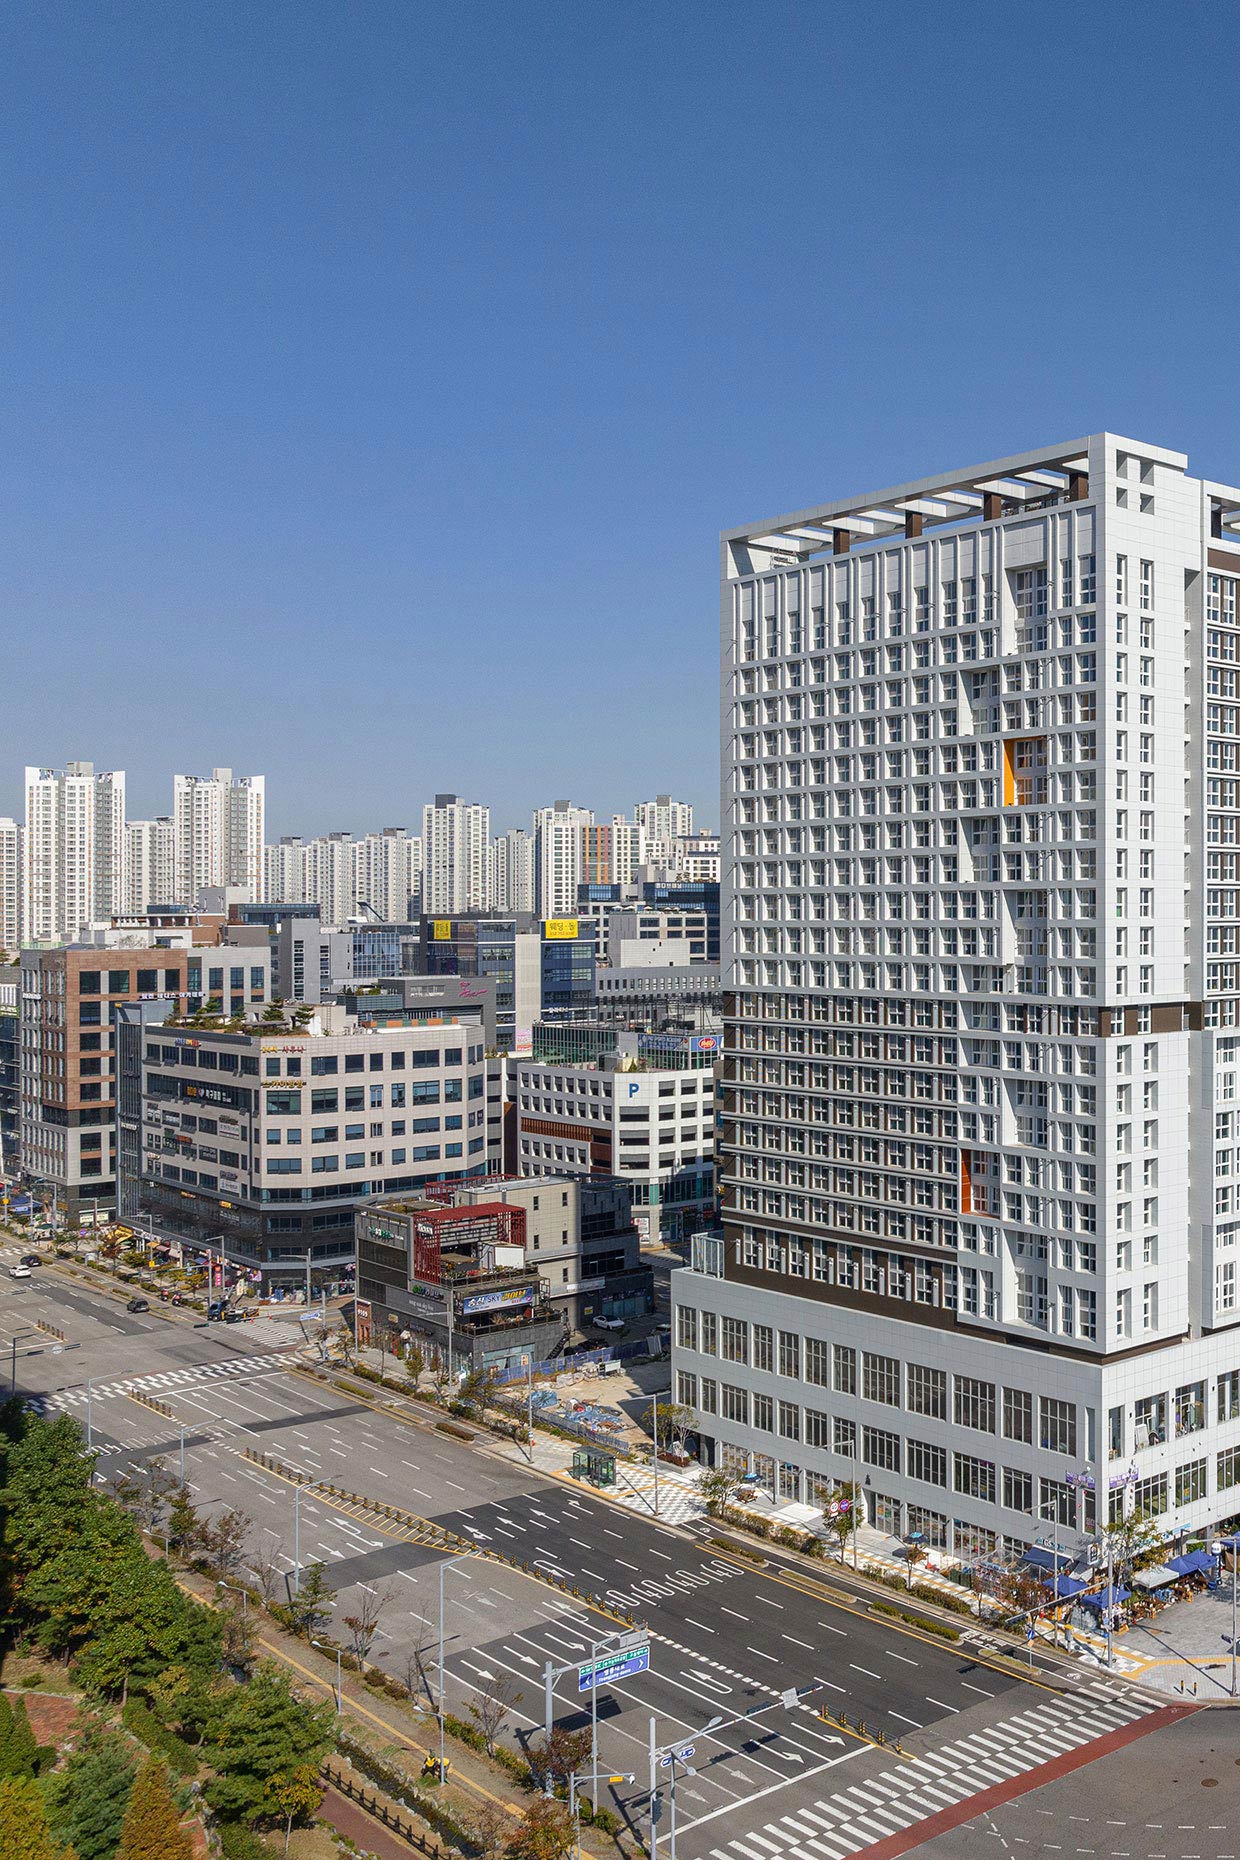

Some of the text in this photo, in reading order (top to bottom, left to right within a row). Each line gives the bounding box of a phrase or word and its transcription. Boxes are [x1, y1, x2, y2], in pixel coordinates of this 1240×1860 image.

[628, 1083, 640, 1098] P
[487, 1295, 500, 1303] SKY
[700, 1560, 744, 1578] 40
[665, 1570, 710, 1588] 40
[630, 1580, 675, 1599] 40
[595, 1589, 640, 1609] 40
